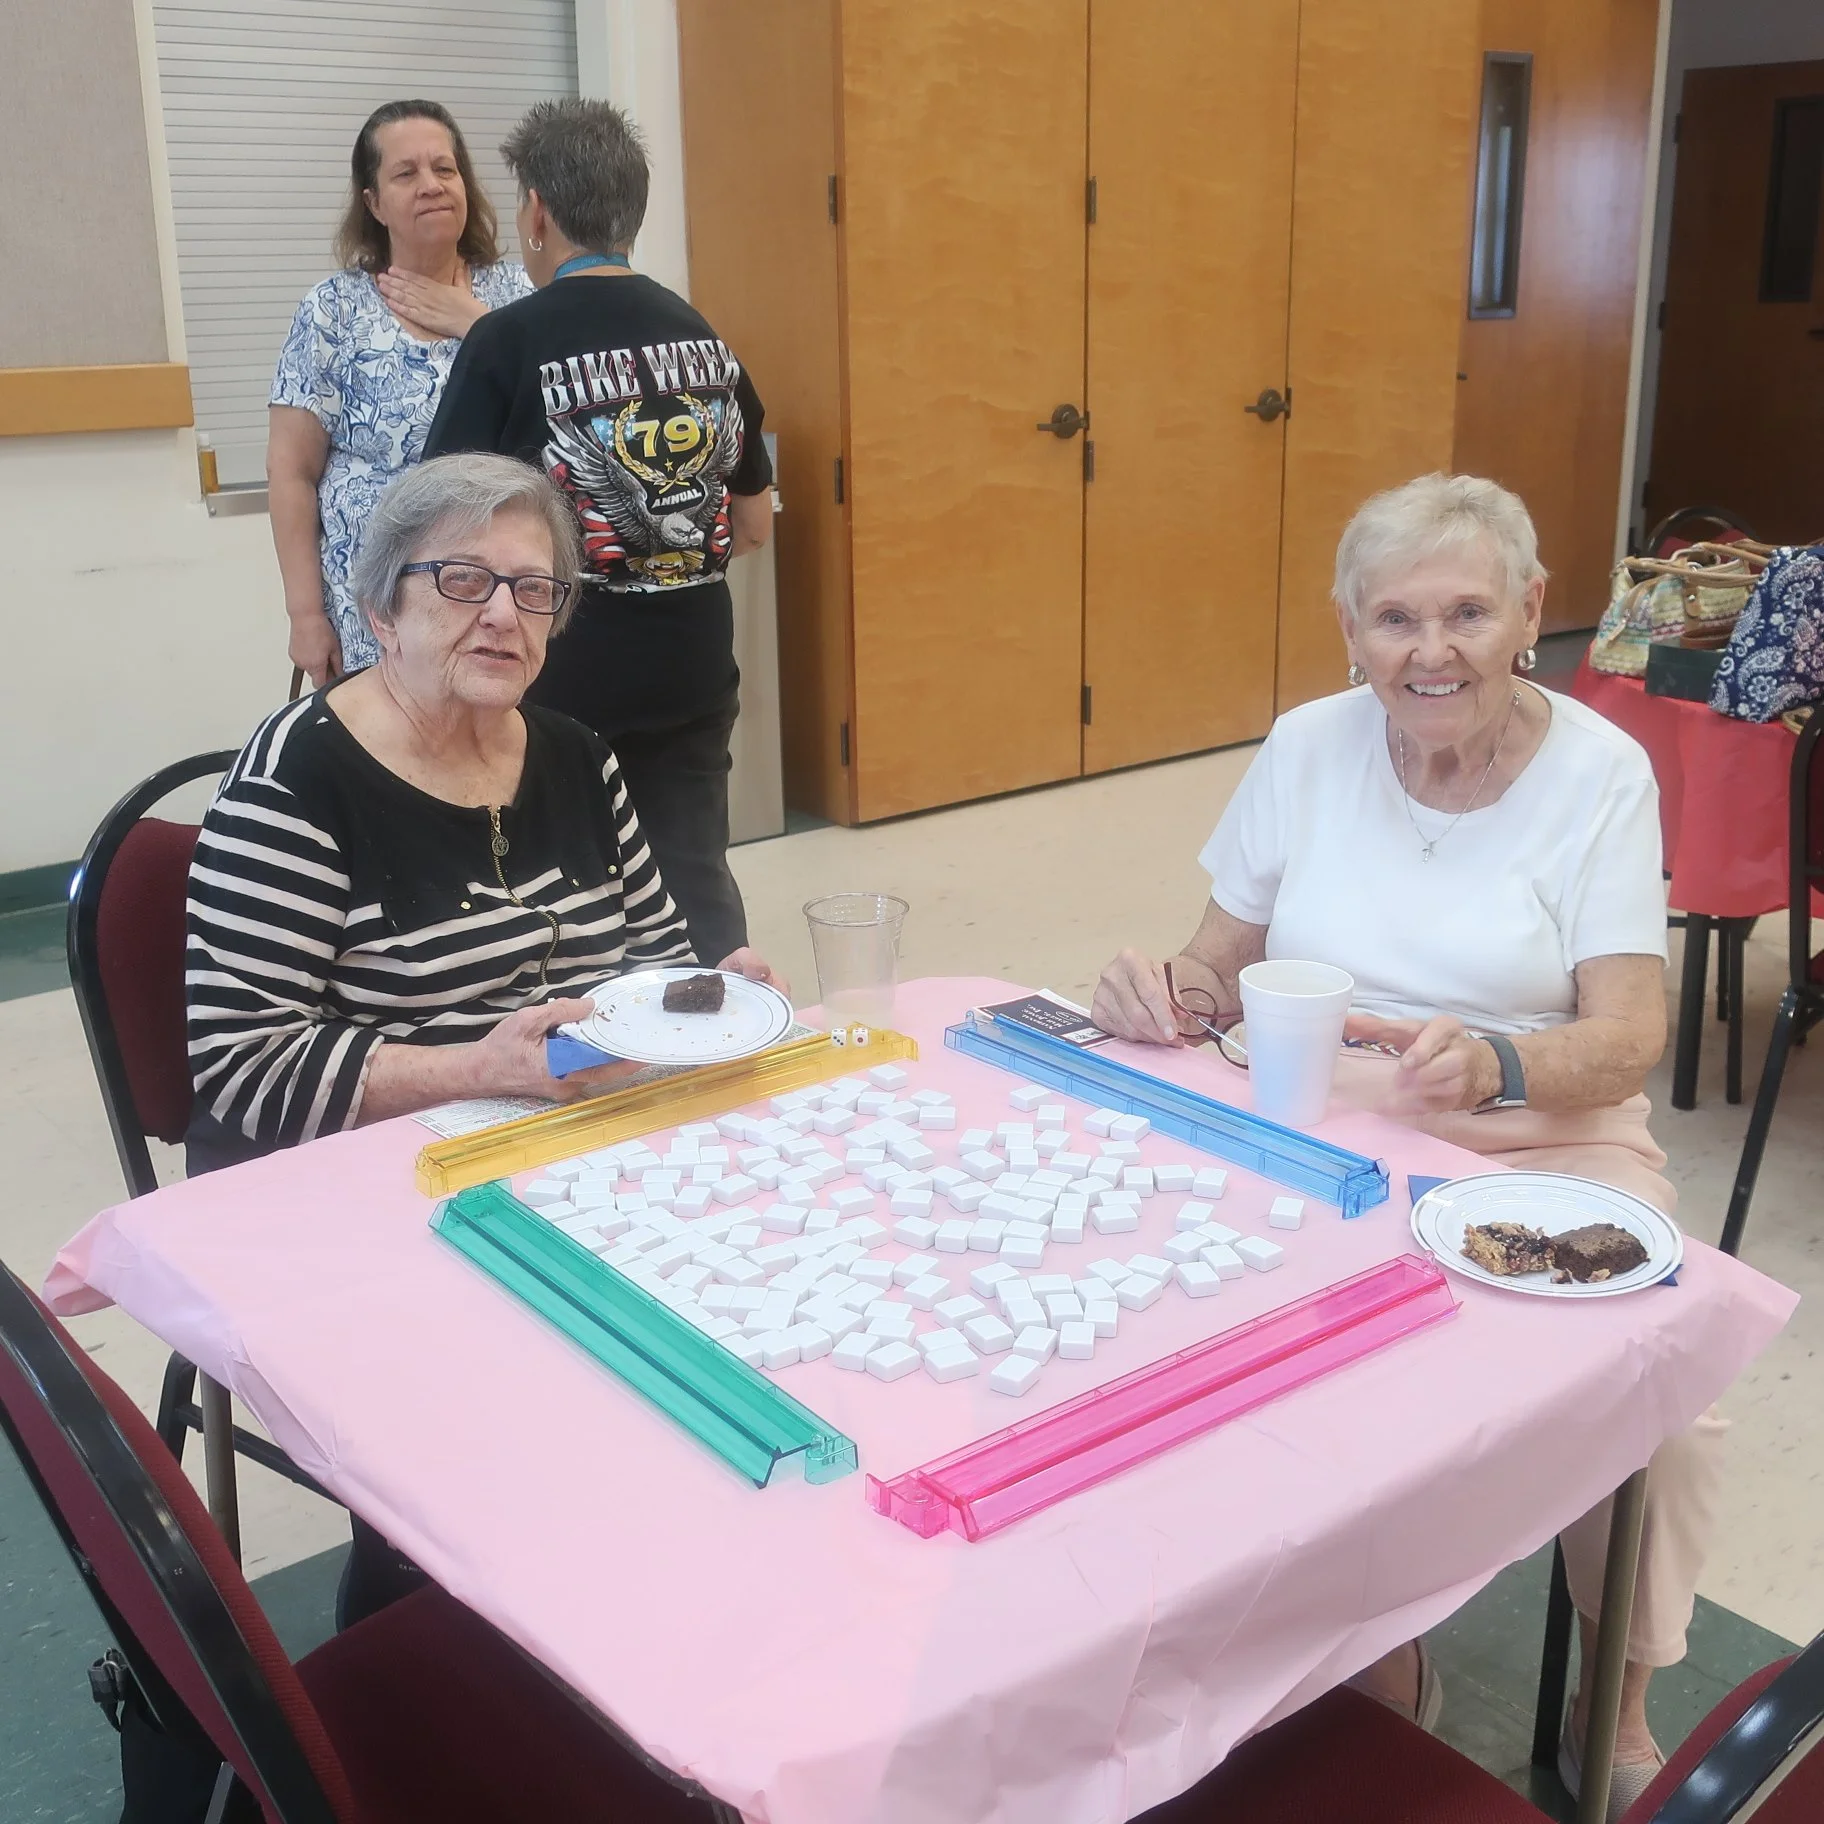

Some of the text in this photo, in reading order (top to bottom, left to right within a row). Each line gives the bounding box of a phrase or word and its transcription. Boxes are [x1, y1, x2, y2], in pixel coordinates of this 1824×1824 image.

[539, 348, 642, 416] BIKE
[631, 414, 701, 458] 79
[651, 488, 702, 509] ANNUAL
